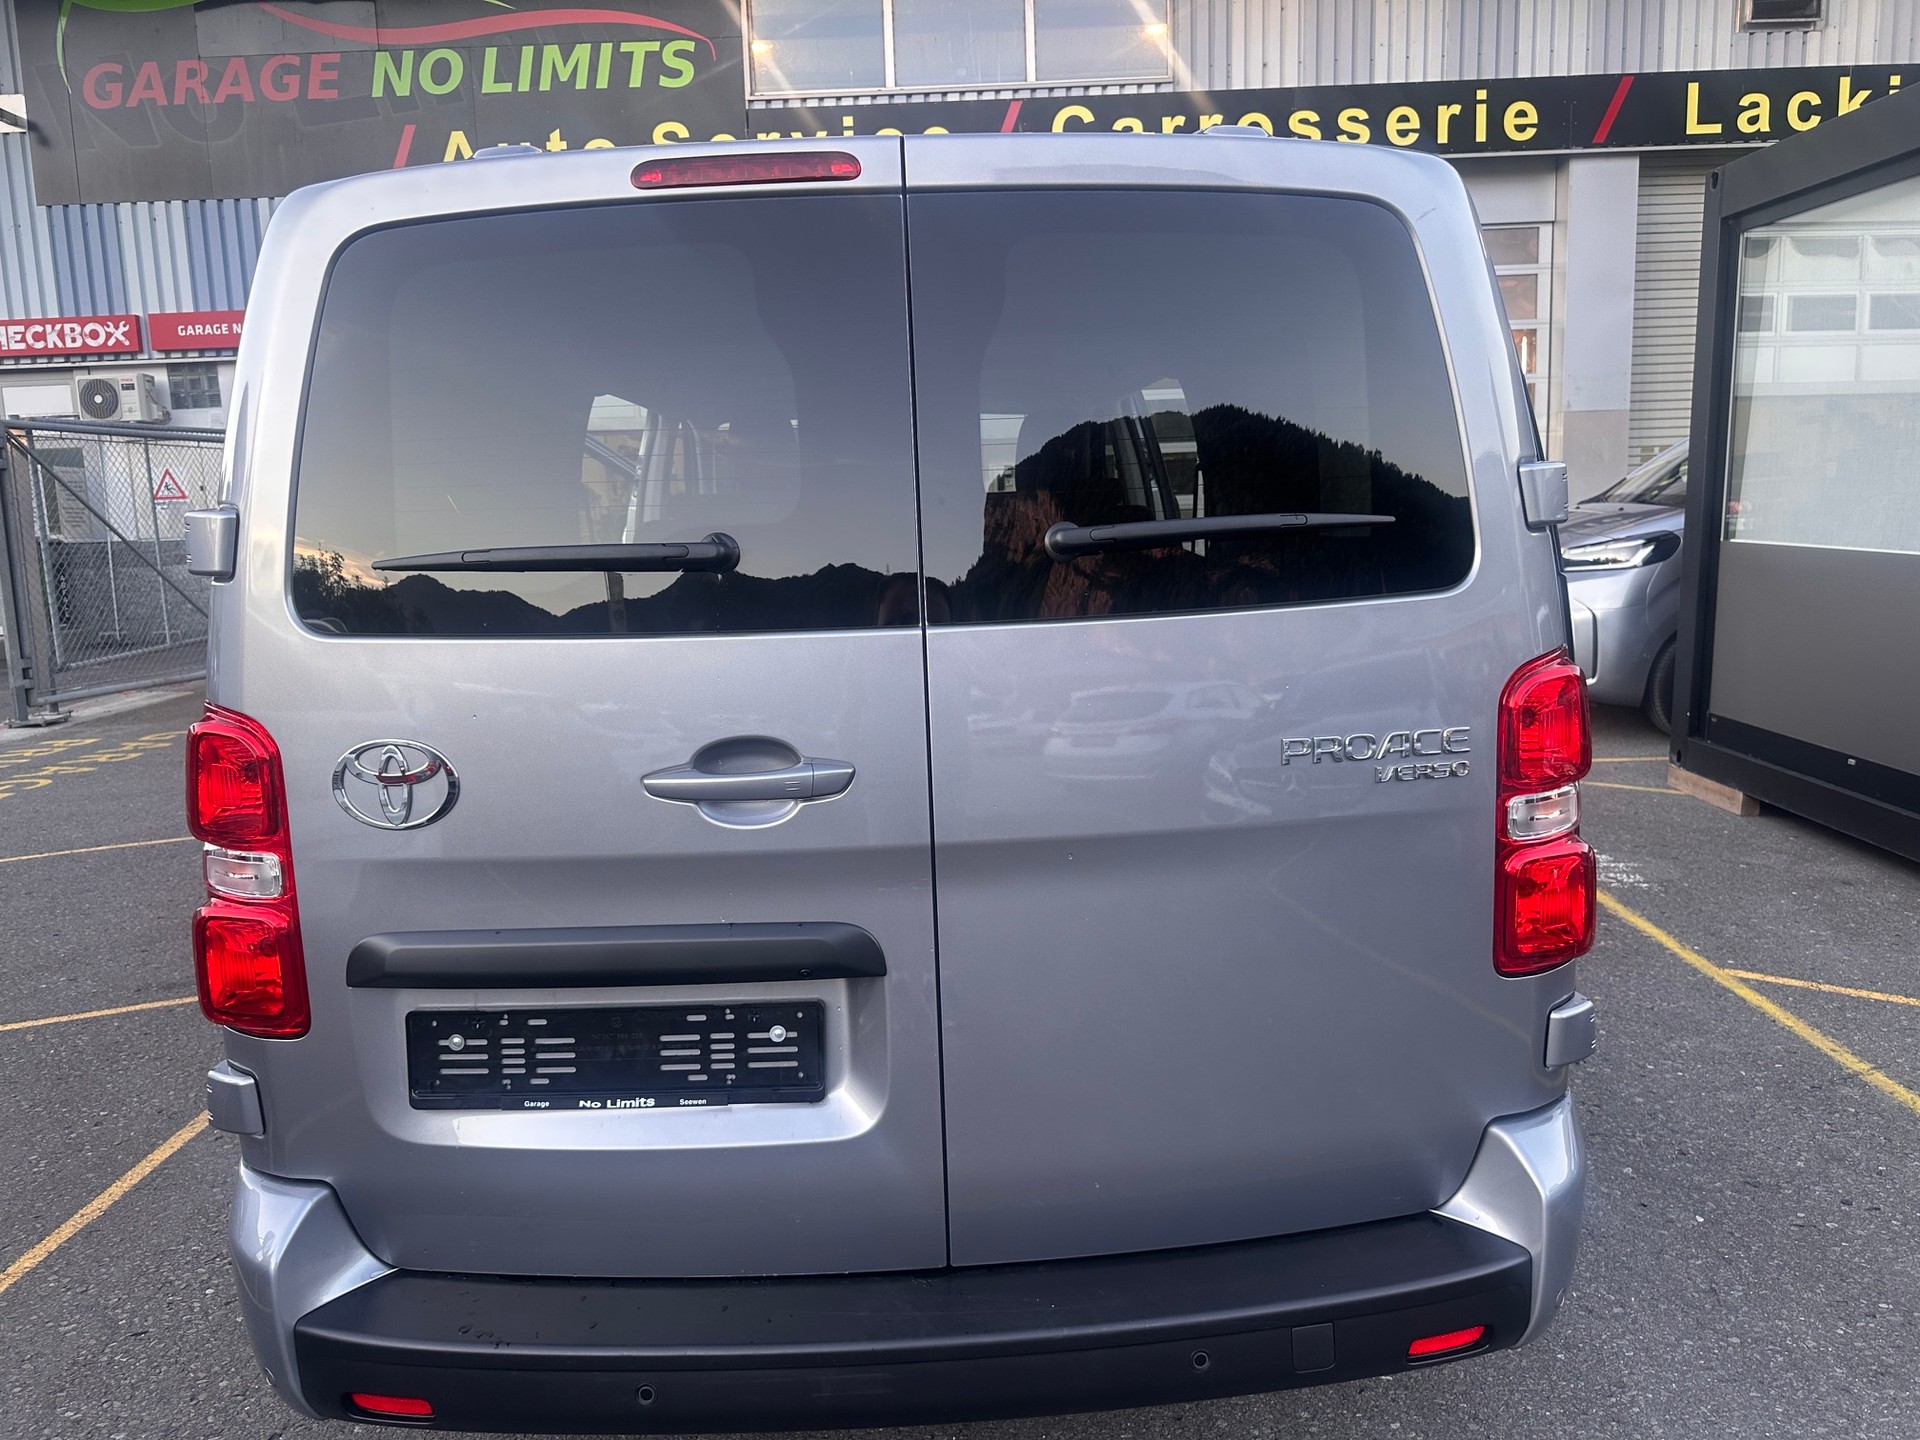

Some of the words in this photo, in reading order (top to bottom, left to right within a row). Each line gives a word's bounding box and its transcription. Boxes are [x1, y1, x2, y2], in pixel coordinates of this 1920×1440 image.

[83, 53, 342, 109] GARAGE
[371, 49, 464, 98] NO
[481, 40, 697, 94] LIMITS
[177, 323, 229, 336] GARAGE
[1281, 727, 1471, 765] PROACE
[1375, 761, 1470, 783] VERSO
[579, 1100, 601, 1108] No
[606, 1097, 656, 1108] Limits
